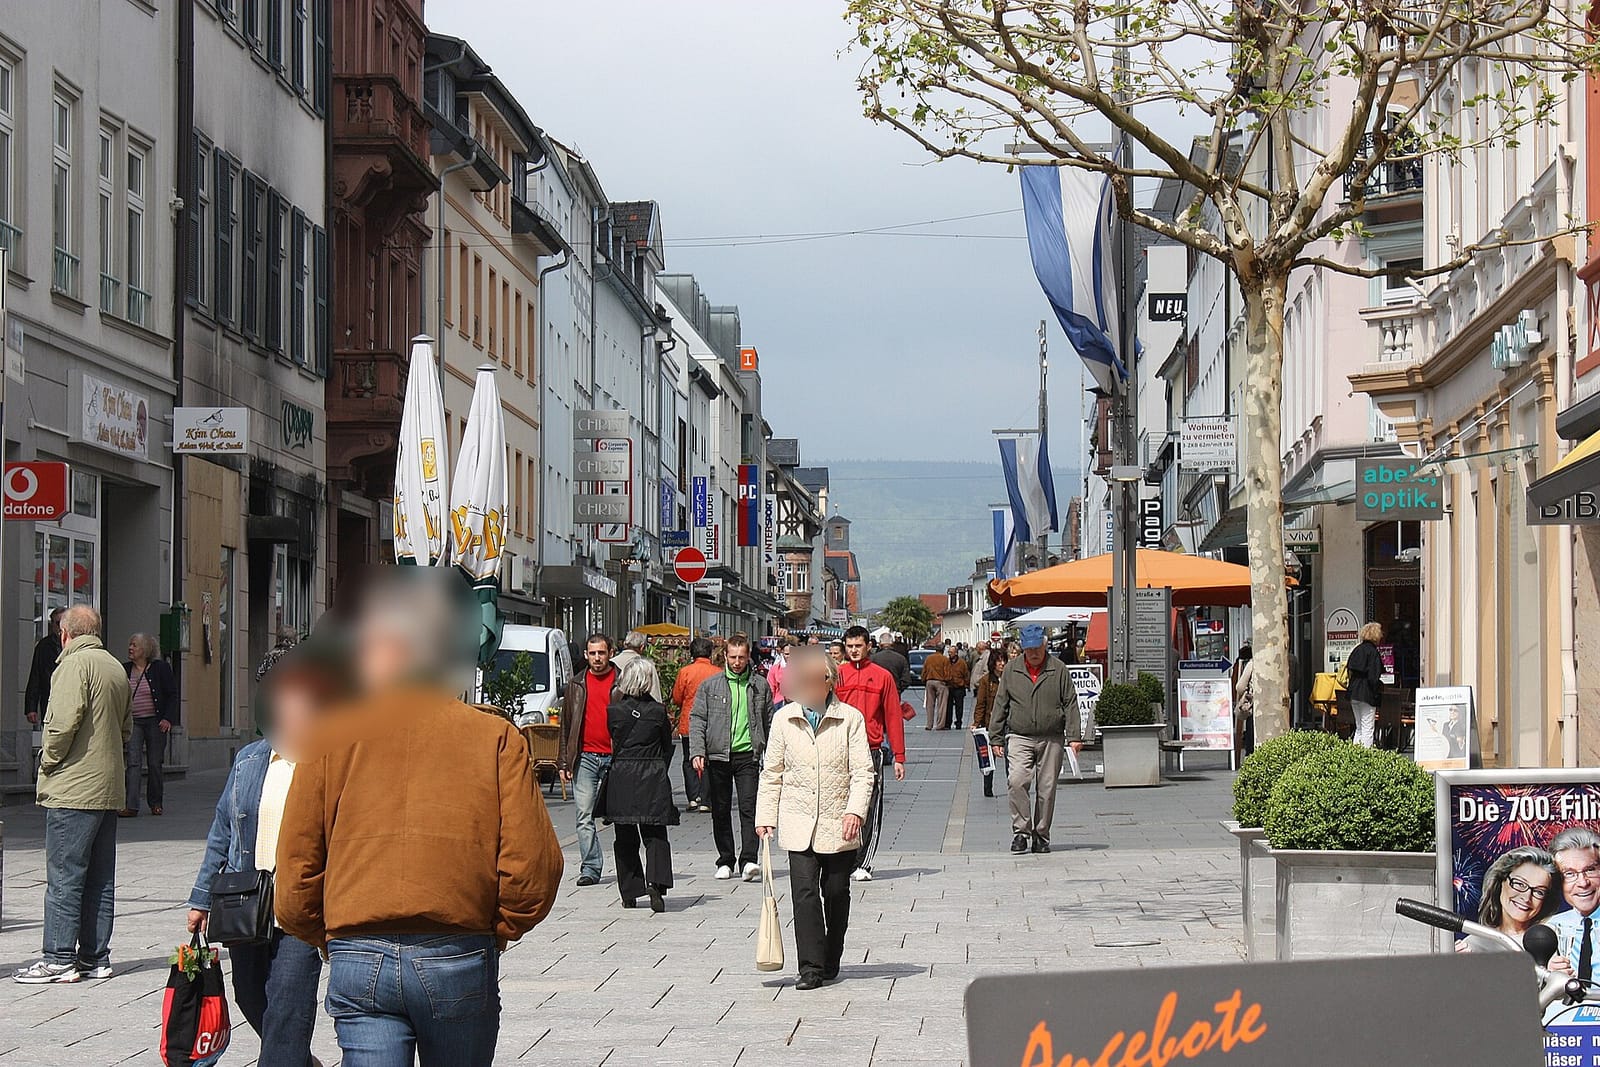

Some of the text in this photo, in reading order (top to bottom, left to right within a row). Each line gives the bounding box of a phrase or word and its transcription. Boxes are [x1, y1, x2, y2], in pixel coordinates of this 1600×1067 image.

[1155, 299, 1183, 314] NEU
[577, 417, 625, 432] CHRIST
[1187, 423, 1229, 433] Wohnung
[185, 428, 208, 440] Kim
[1193, 431, 1235, 441] vermieten
[577, 459, 625, 475] CHRIST
[695, 477, 705, 527] BICKEL
[1363, 487, 1438, 513] optik.
[1539, 491, 1600, 520] BiB
[577, 502, 625, 517] CHRIST
[764, 499, 773, 553] INTERSPORT
[1071, 671, 1090, 679] OLD
[1459, 793, 1600, 822] Die 700. Fili
[1579, 1006, 1600, 1017] APO
[1543, 1032, 1583, 1050] läser
[1544, 1051, 1583, 1067] läser
